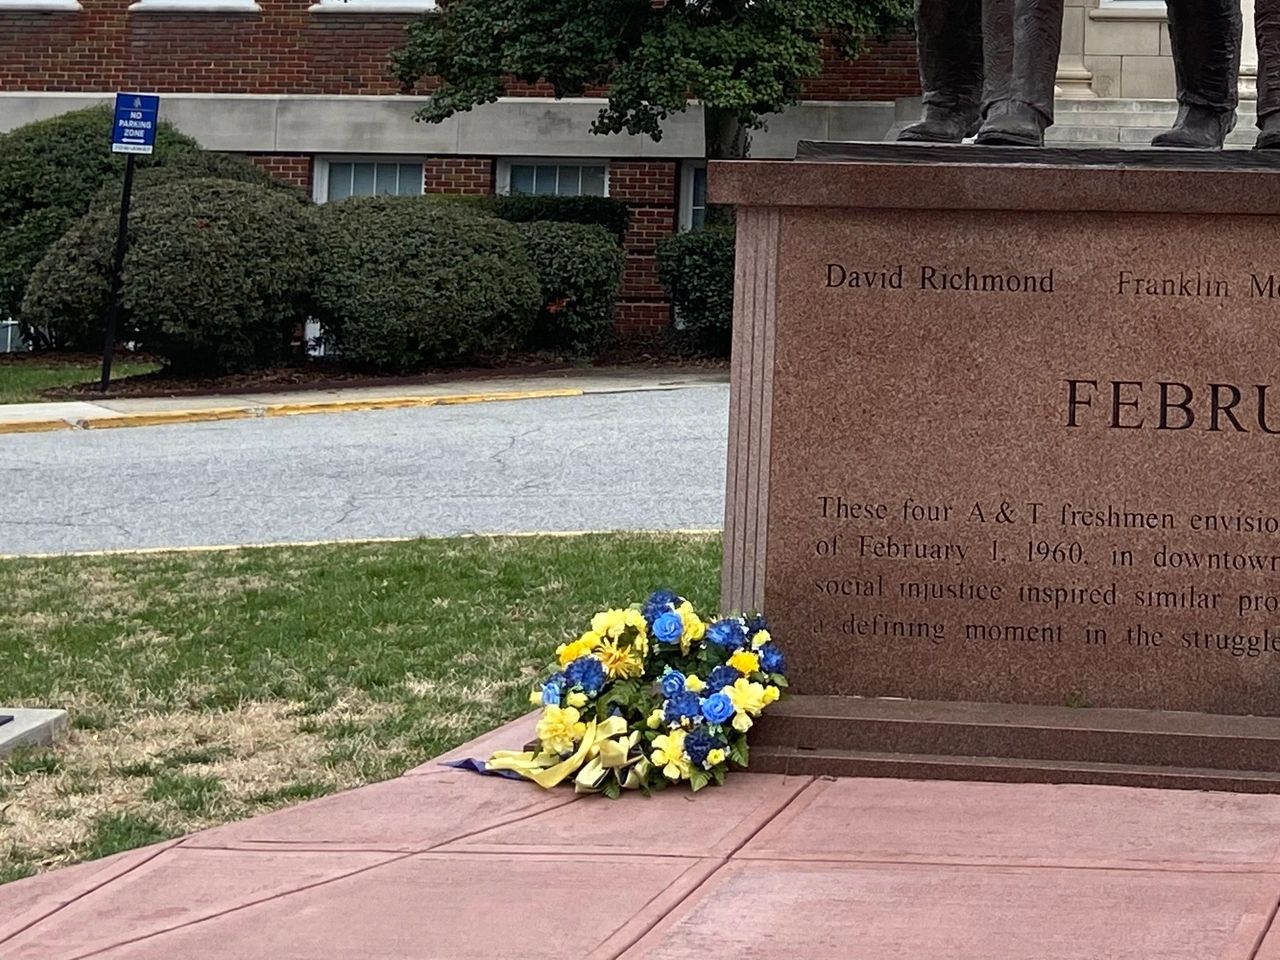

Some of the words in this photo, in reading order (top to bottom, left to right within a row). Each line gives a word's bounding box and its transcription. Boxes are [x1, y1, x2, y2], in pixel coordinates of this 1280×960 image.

[118, 120, 152, 128] PARKING
[130, 111, 142, 119] NO
[123, 129, 145, 137] ZONE
[825, 262, 902, 290] David
[919, 265, 1055, 294] Richmond
[1117, 269, 1229, 300] Franklin
[817, 496, 889, 521] These
[902, 498, 953, 523] four
[967, 501, 987, 524] A
[994, 500, 1017, 526] &
[1026, 502, 1044, 525] T
[1060, 502, 1176, 530] freshmen
[816, 534, 840, 557] of
[858, 534, 970, 567] February
[1111, 544, 1135, 568] in
[814, 575, 884, 598] social
[899, 577, 1003, 604] injustice
[1019, 581, 1118, 611] inspired
[1134, 585, 1222, 611] similar
[812, 617, 825, 636] a
[841, 613, 946, 646] defining
[964, 621, 1064, 644] moment
[1085, 623, 1108, 646] in
[1126, 623, 1164, 649] the
